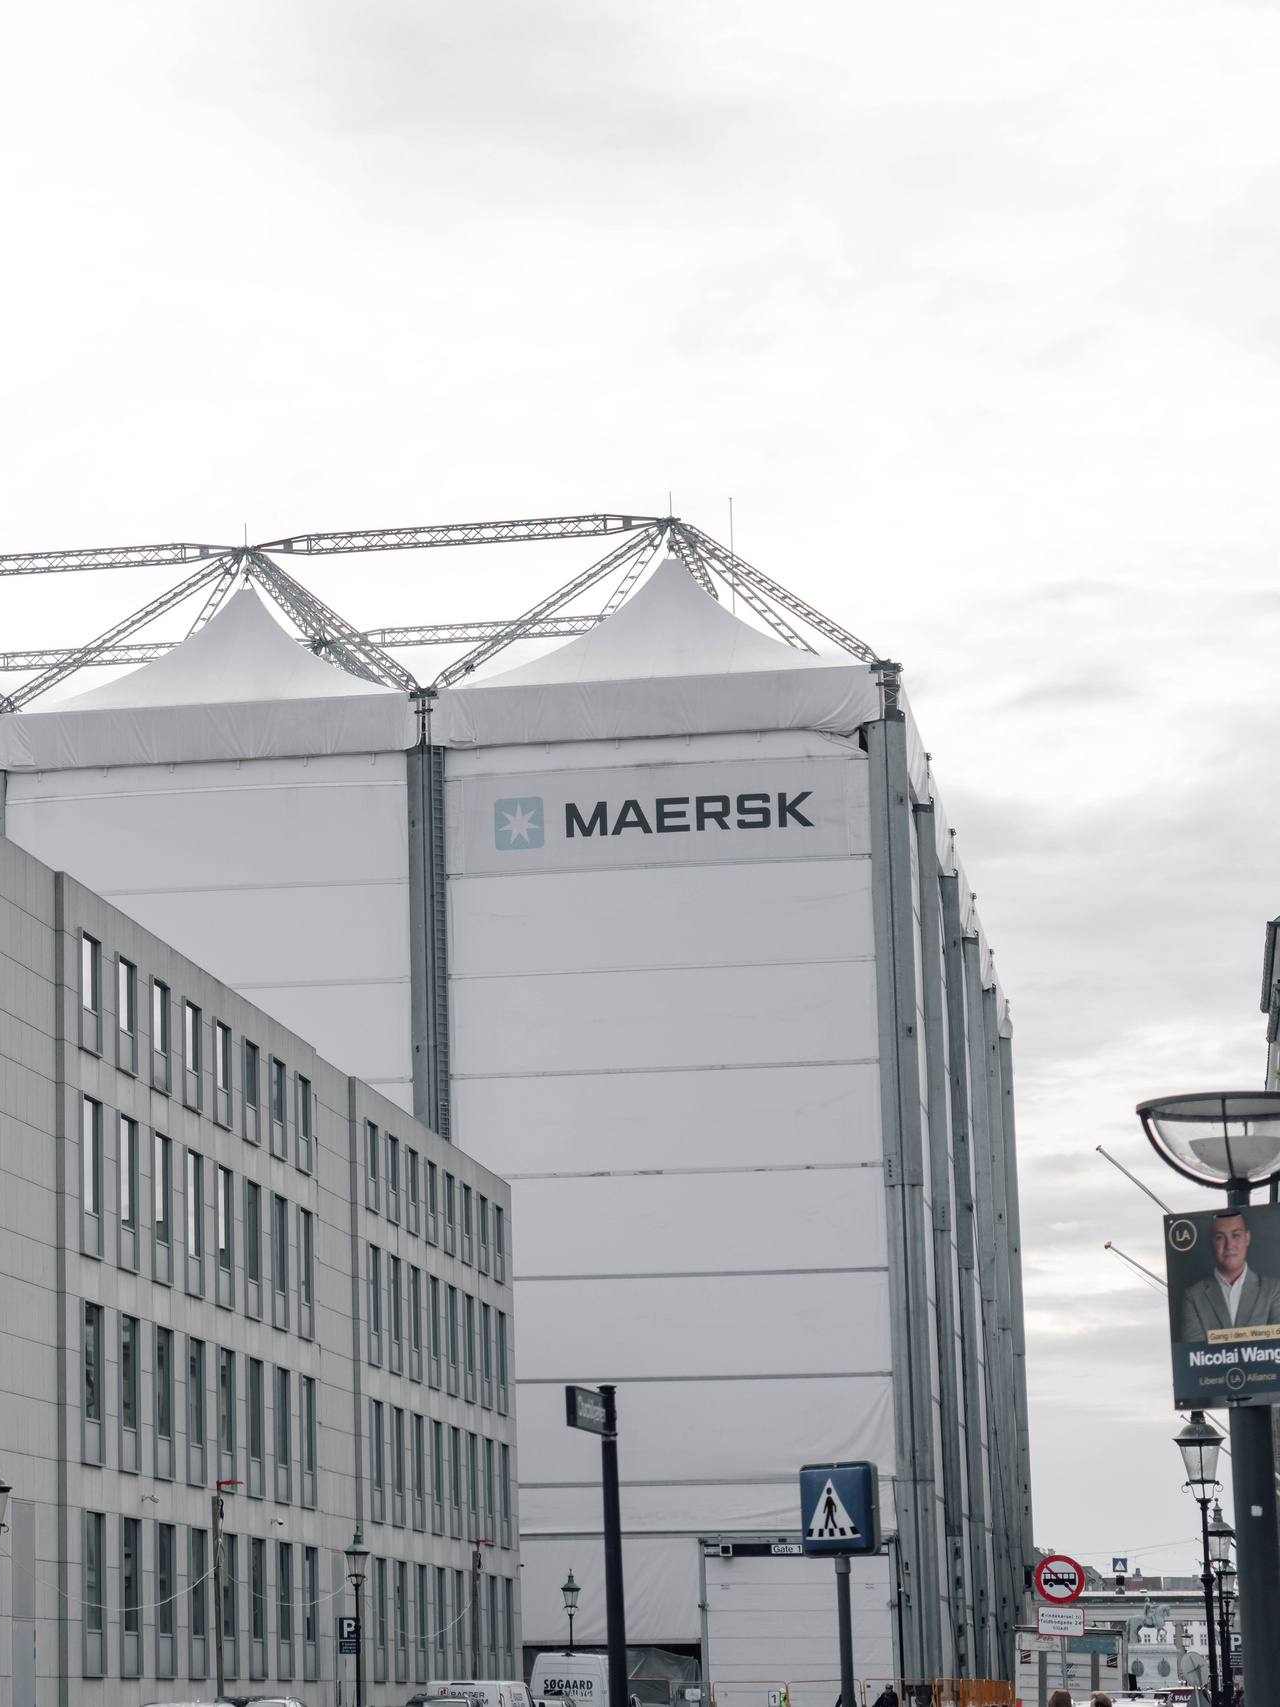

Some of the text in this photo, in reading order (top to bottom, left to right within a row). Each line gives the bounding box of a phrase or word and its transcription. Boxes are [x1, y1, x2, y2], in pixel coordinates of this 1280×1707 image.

[565, 791, 815, 838] MAERSK
[1176, 1230, 1191, 1241] LA
[1210, 1333, 1228, 1341] Gang
[1250, 1329, 1270, 1337] Wang
[1189, 1346, 1280, 1367] Nicolai Wang
[1200, 1373, 1277, 1385] Liberal LA Alliance
[343, 1620, 355, 1638] P
[1230, 1634, 1242, 1651] P
[543, 1679, 593, 1690] SØGAARD
[771, 1694, 777, 1704] 1
